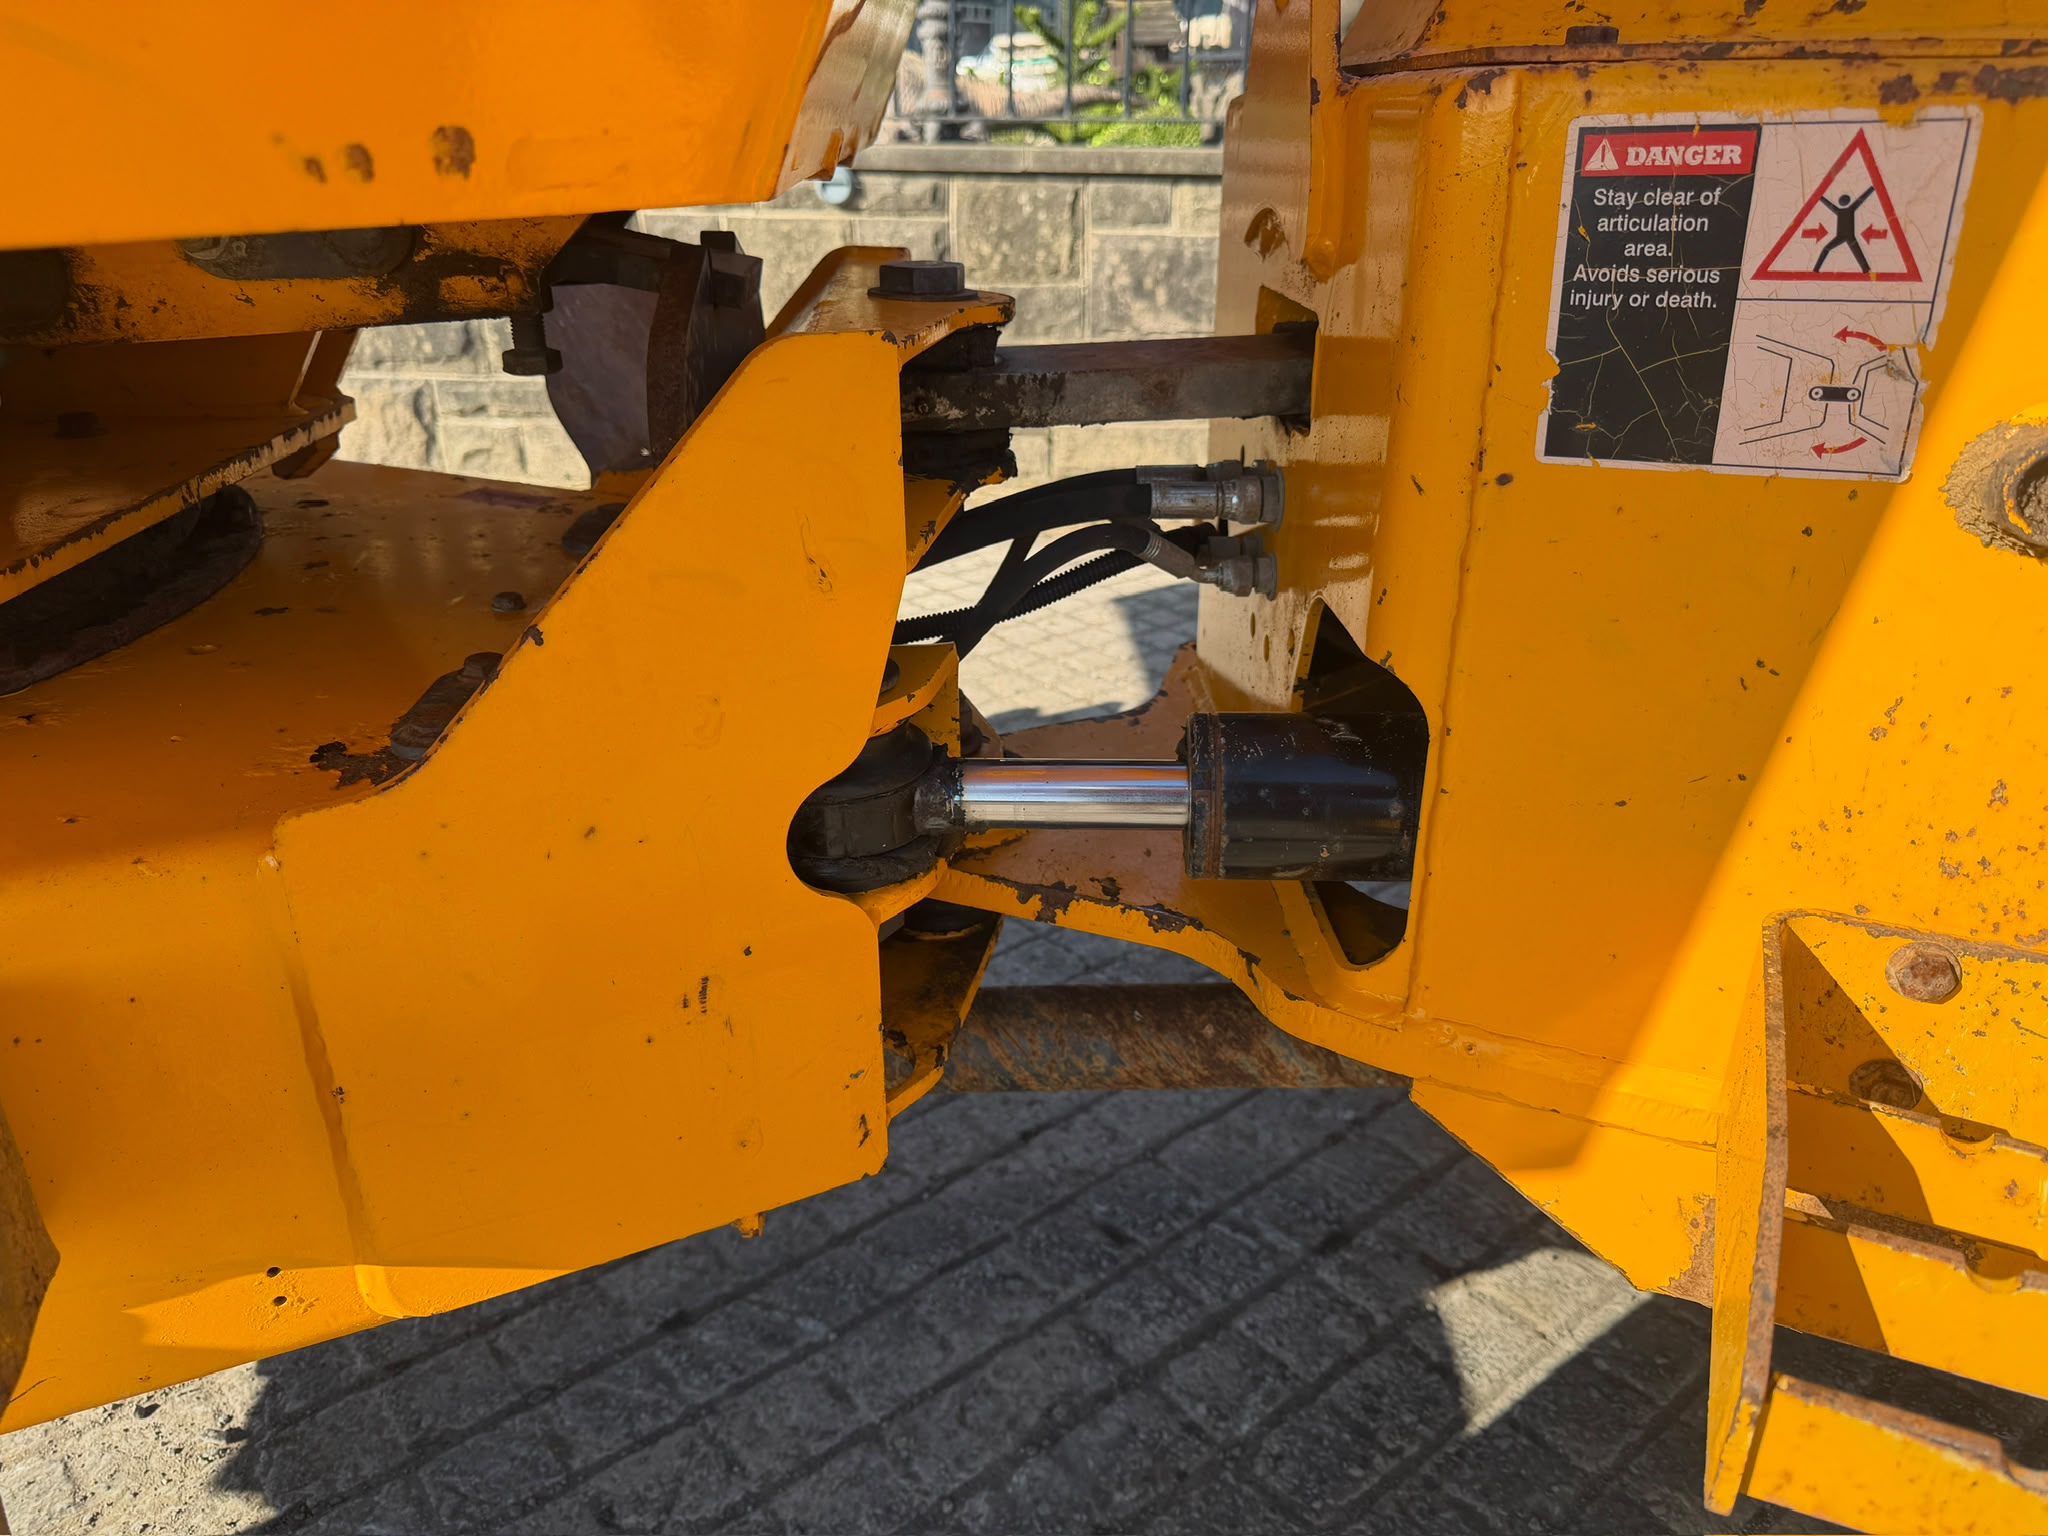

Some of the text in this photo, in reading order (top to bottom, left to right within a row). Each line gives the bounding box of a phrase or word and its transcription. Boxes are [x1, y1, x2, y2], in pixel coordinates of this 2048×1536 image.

[1625, 145, 1742, 166] DANGER
[1593, 187, 1722, 210] Stay clear of
[1597, 214, 1709, 232] articulation
[1624, 242, 1672, 257] area.
[1573, 264, 1721, 284] Avoids serious
[1569, 289, 1717, 311] injury or death.
